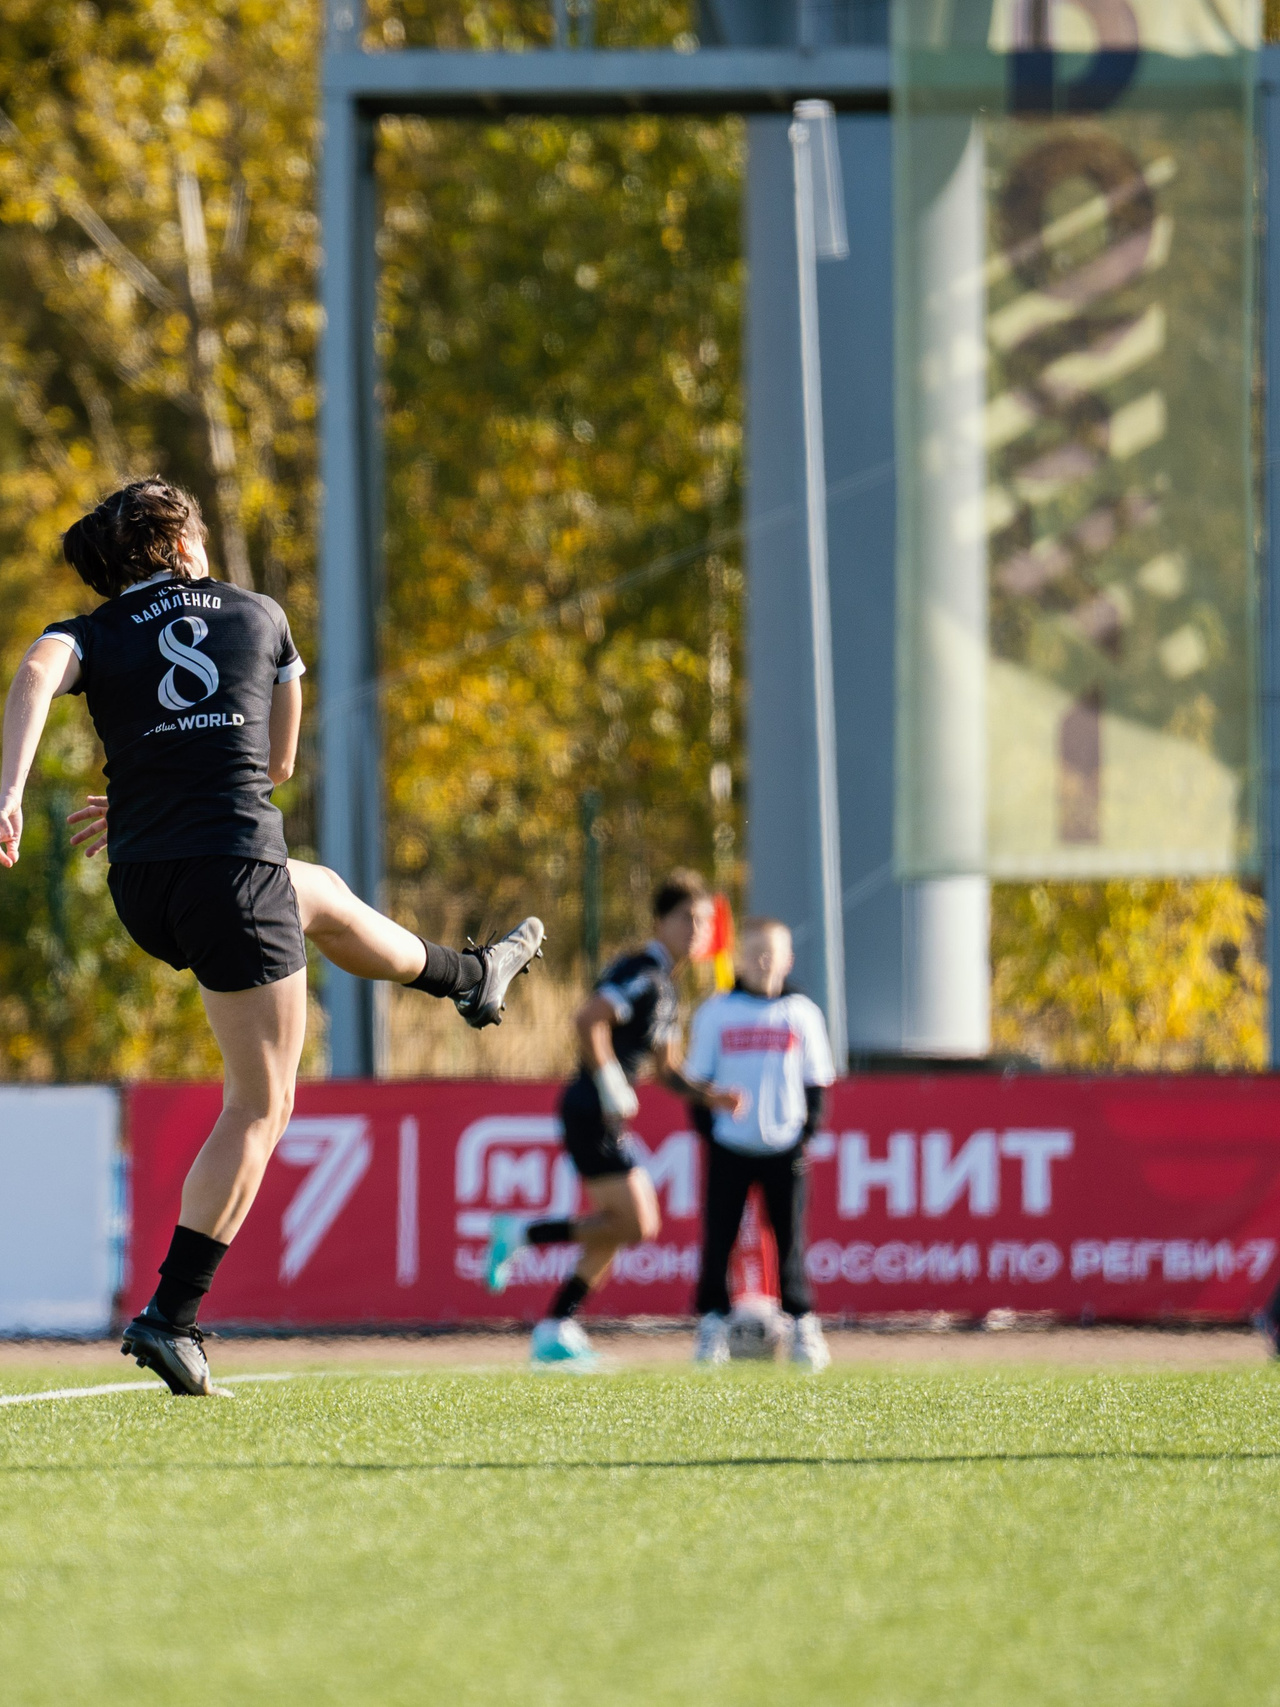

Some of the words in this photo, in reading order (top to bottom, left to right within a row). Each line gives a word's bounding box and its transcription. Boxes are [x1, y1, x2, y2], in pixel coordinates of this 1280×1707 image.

[157, 615, 220, 712] 8
[177, 712, 246, 731] WORLD
[804, 1239, 981, 1284] ОССИИ
[986, 1240, 1065, 1284] ПО
